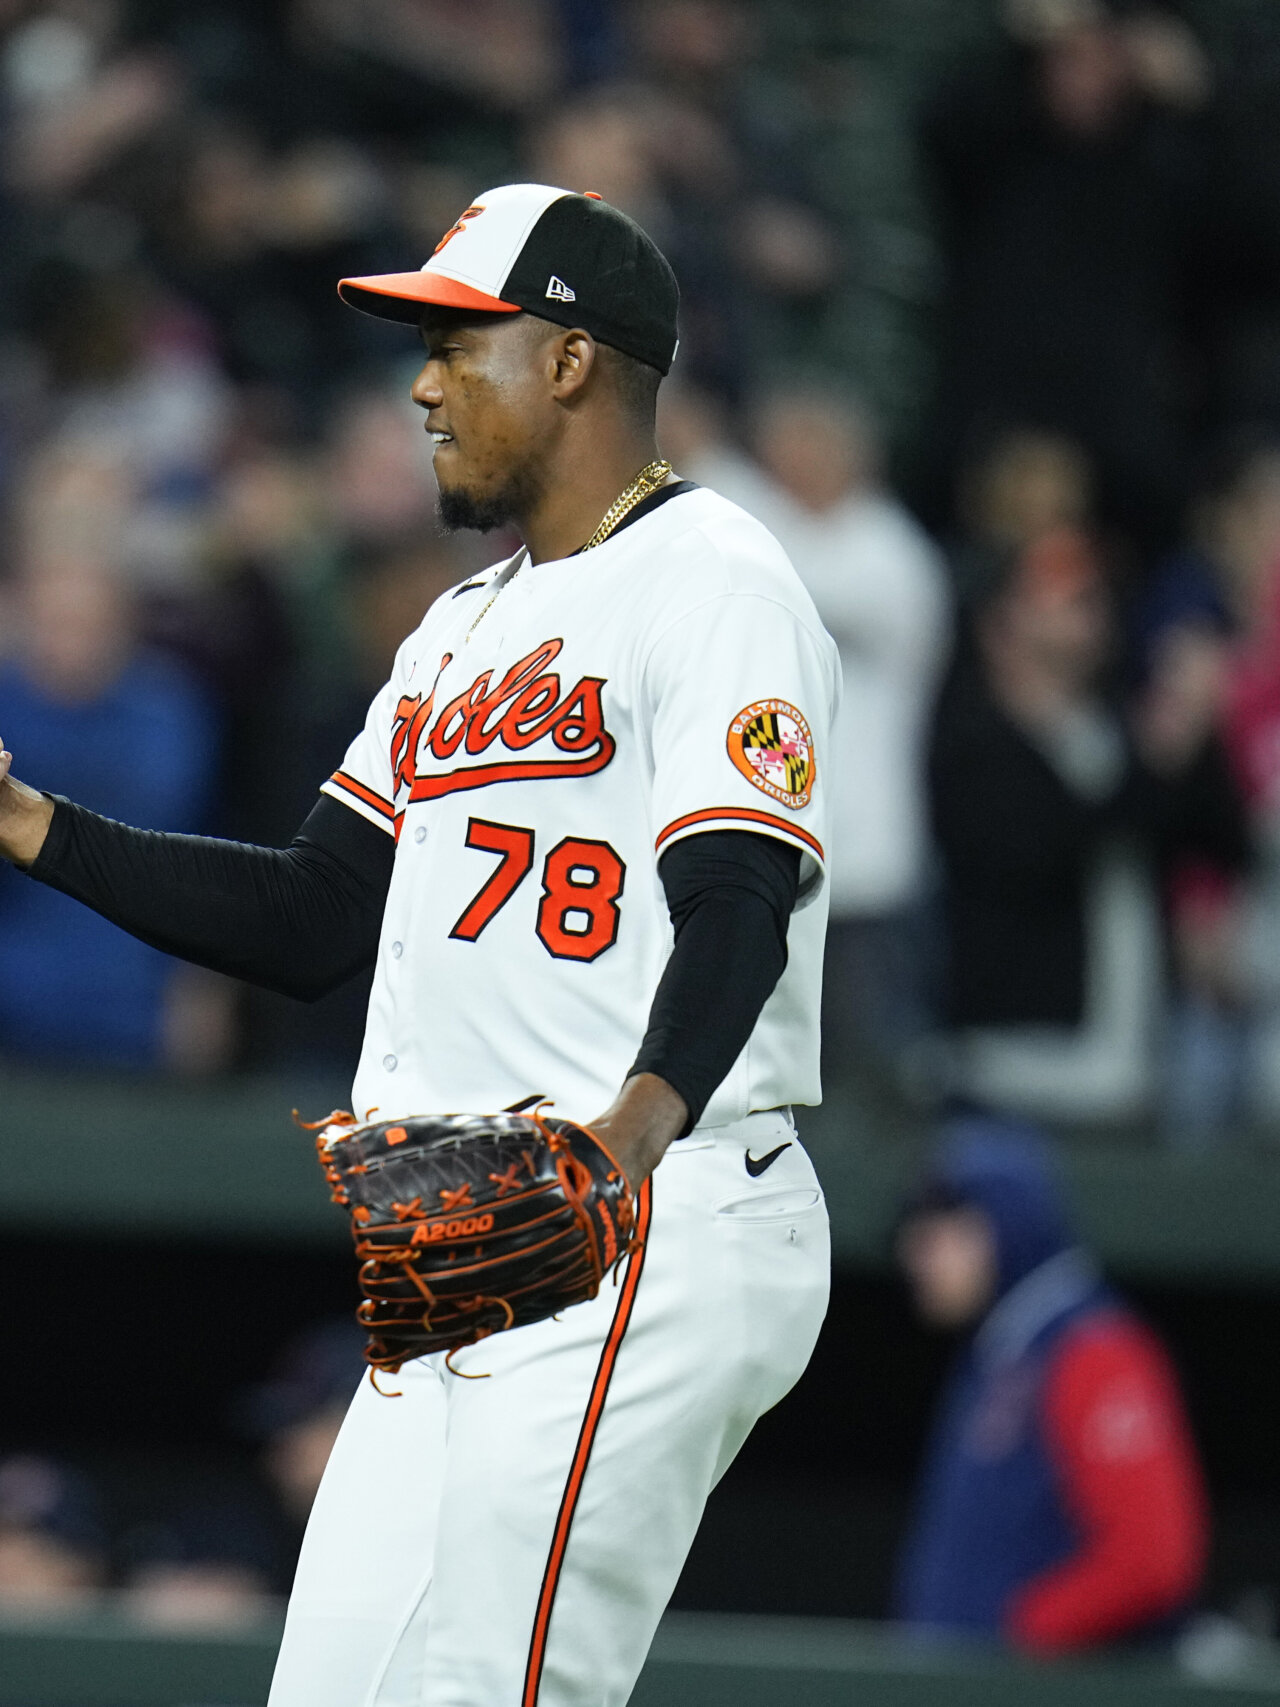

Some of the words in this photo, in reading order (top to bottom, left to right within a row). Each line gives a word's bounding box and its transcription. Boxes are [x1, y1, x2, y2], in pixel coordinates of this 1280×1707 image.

[751, 774, 808, 806] ORIOLES
[448, 816, 627, 964] 78
[410, 1213, 494, 1245] A2000
